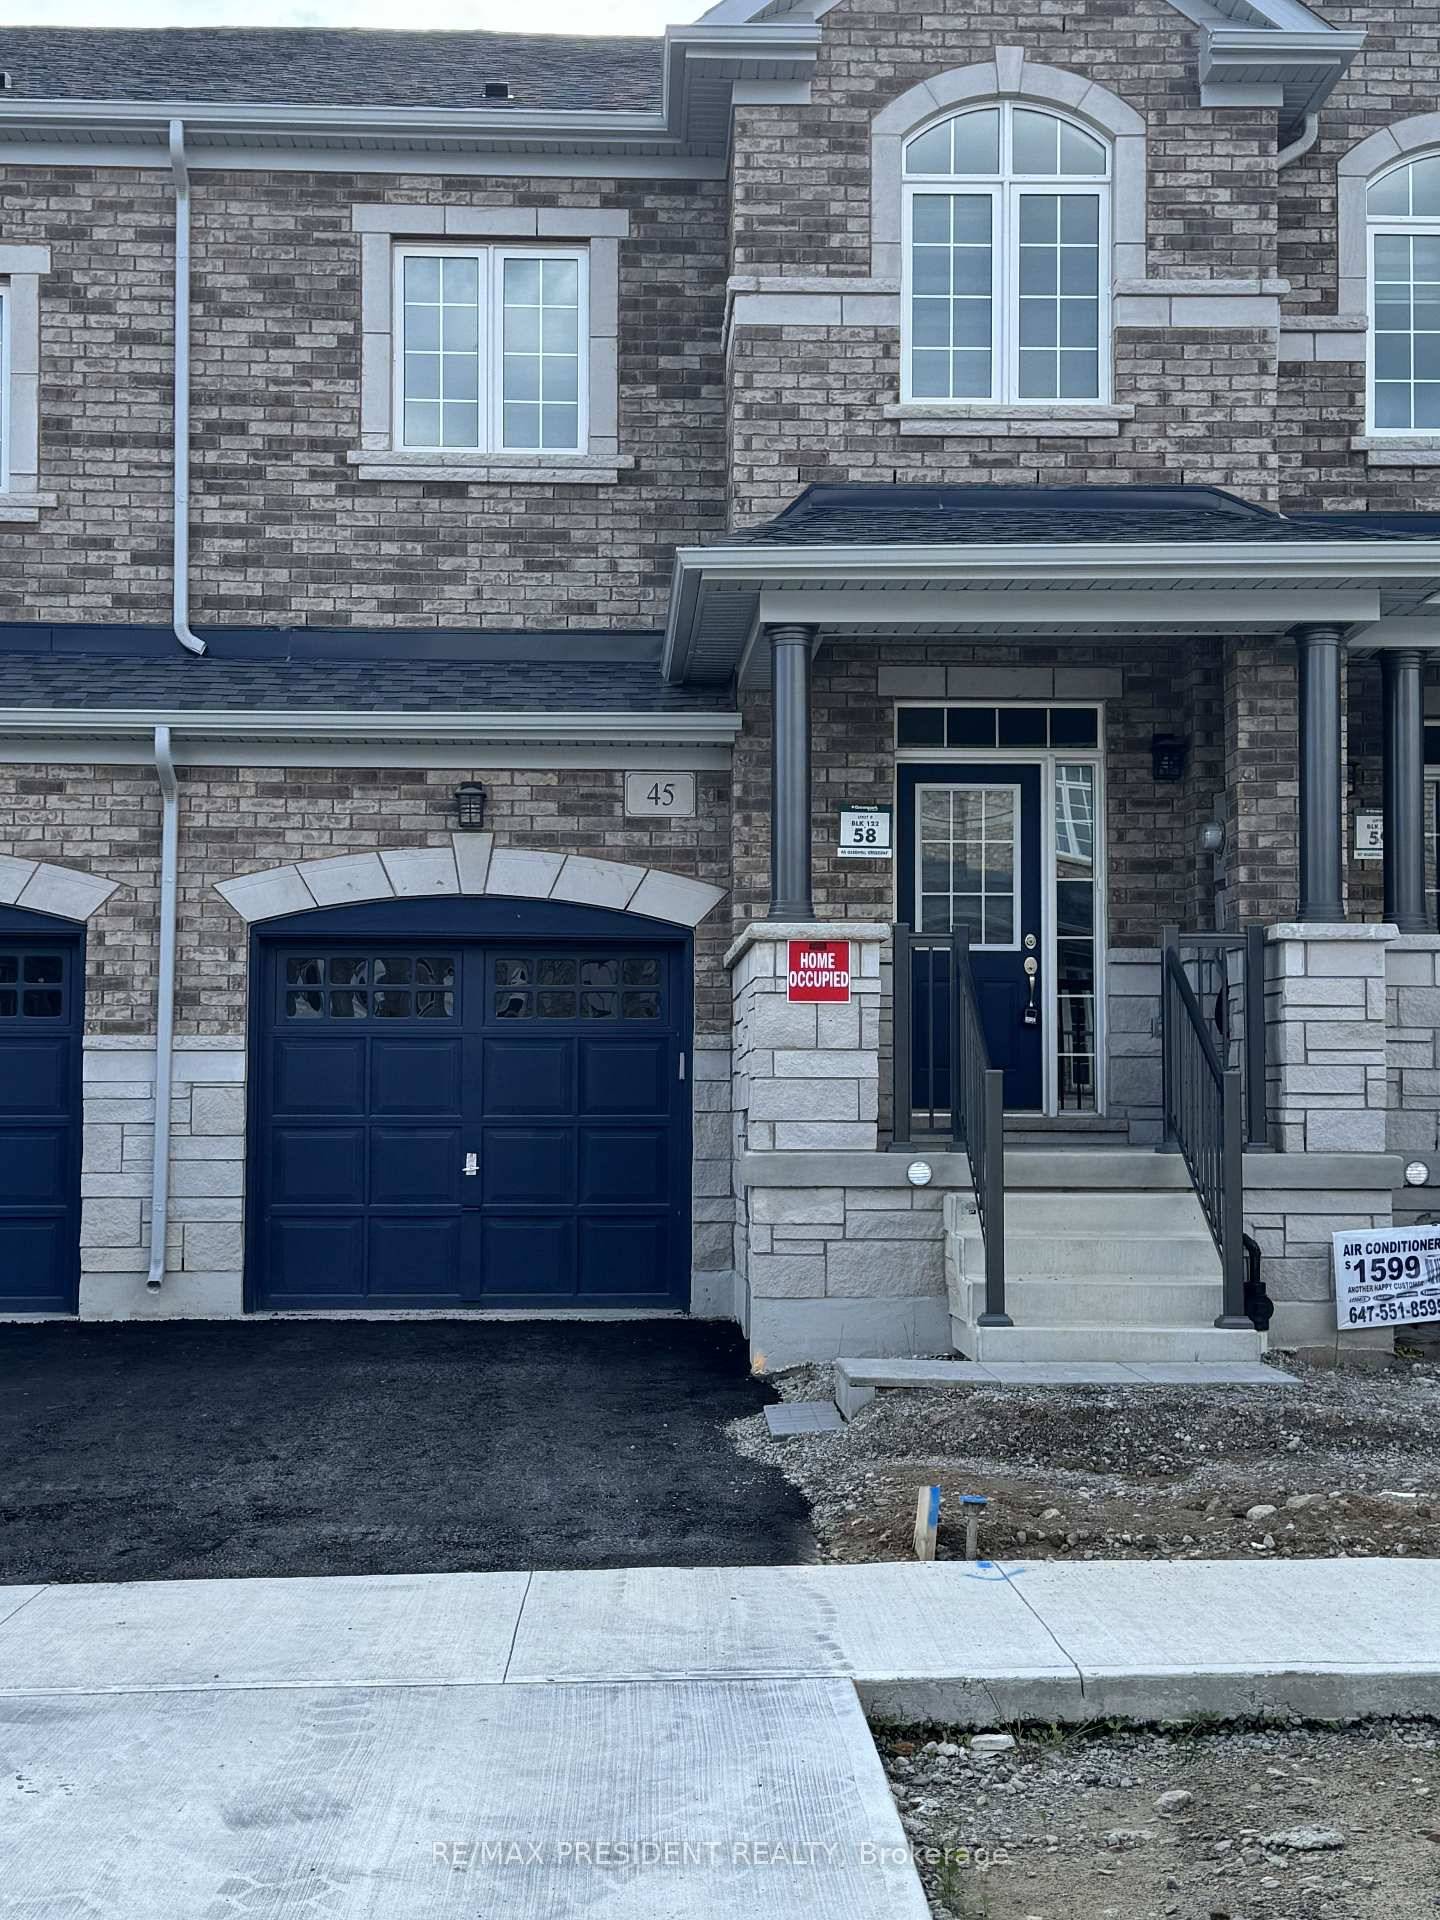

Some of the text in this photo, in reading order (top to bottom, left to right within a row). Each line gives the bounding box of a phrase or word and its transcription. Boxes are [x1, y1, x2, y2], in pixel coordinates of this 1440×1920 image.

[646, 782, 676, 806] 45
[852, 827, 877, 843] 58
[1368, 830, 1384, 846] 5
[800, 952, 836, 969] HOME
[789, 970, 849, 988] OCCUPIED
[1343, 1237, 1440, 1257] AIR CONDITIONER
[1347, 1284, 1374, 1294] ANOTHER
[1374, 1282, 1393, 1292] HAPPY
